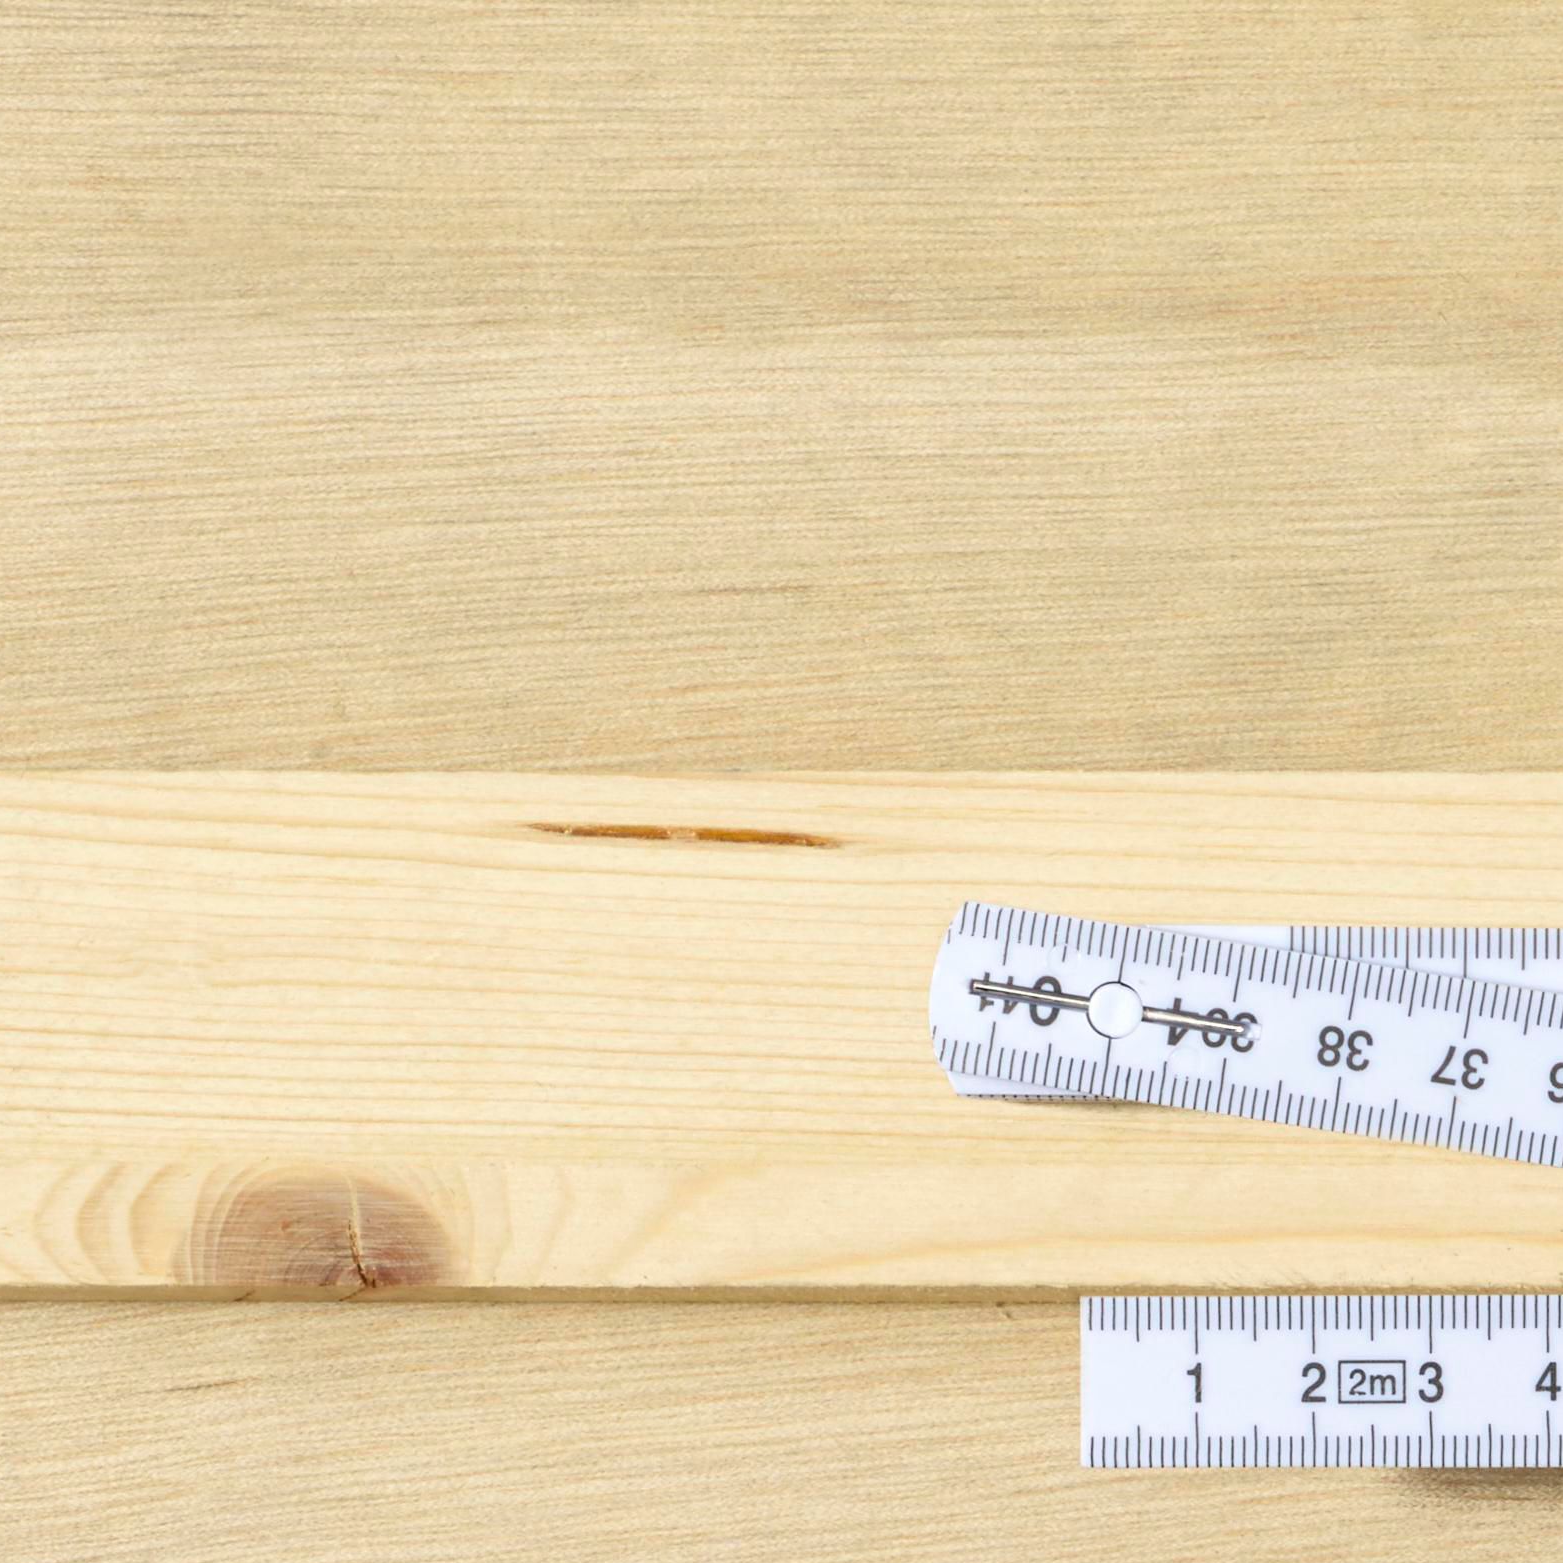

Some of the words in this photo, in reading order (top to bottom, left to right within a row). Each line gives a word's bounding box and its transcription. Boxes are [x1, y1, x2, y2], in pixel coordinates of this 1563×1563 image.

[1317, 1025, 1373, 1072] 38
[1430, 1045, 1489, 1090] 37
[1187, 1362, 1202, 1403] 1
[1301, 1362, 1327, 1403] 2
[1348, 1368, 1397, 1396] 2m
[1418, 1361, 1444, 1403] 3
[1535, 1361, 1562, 1402] 4
